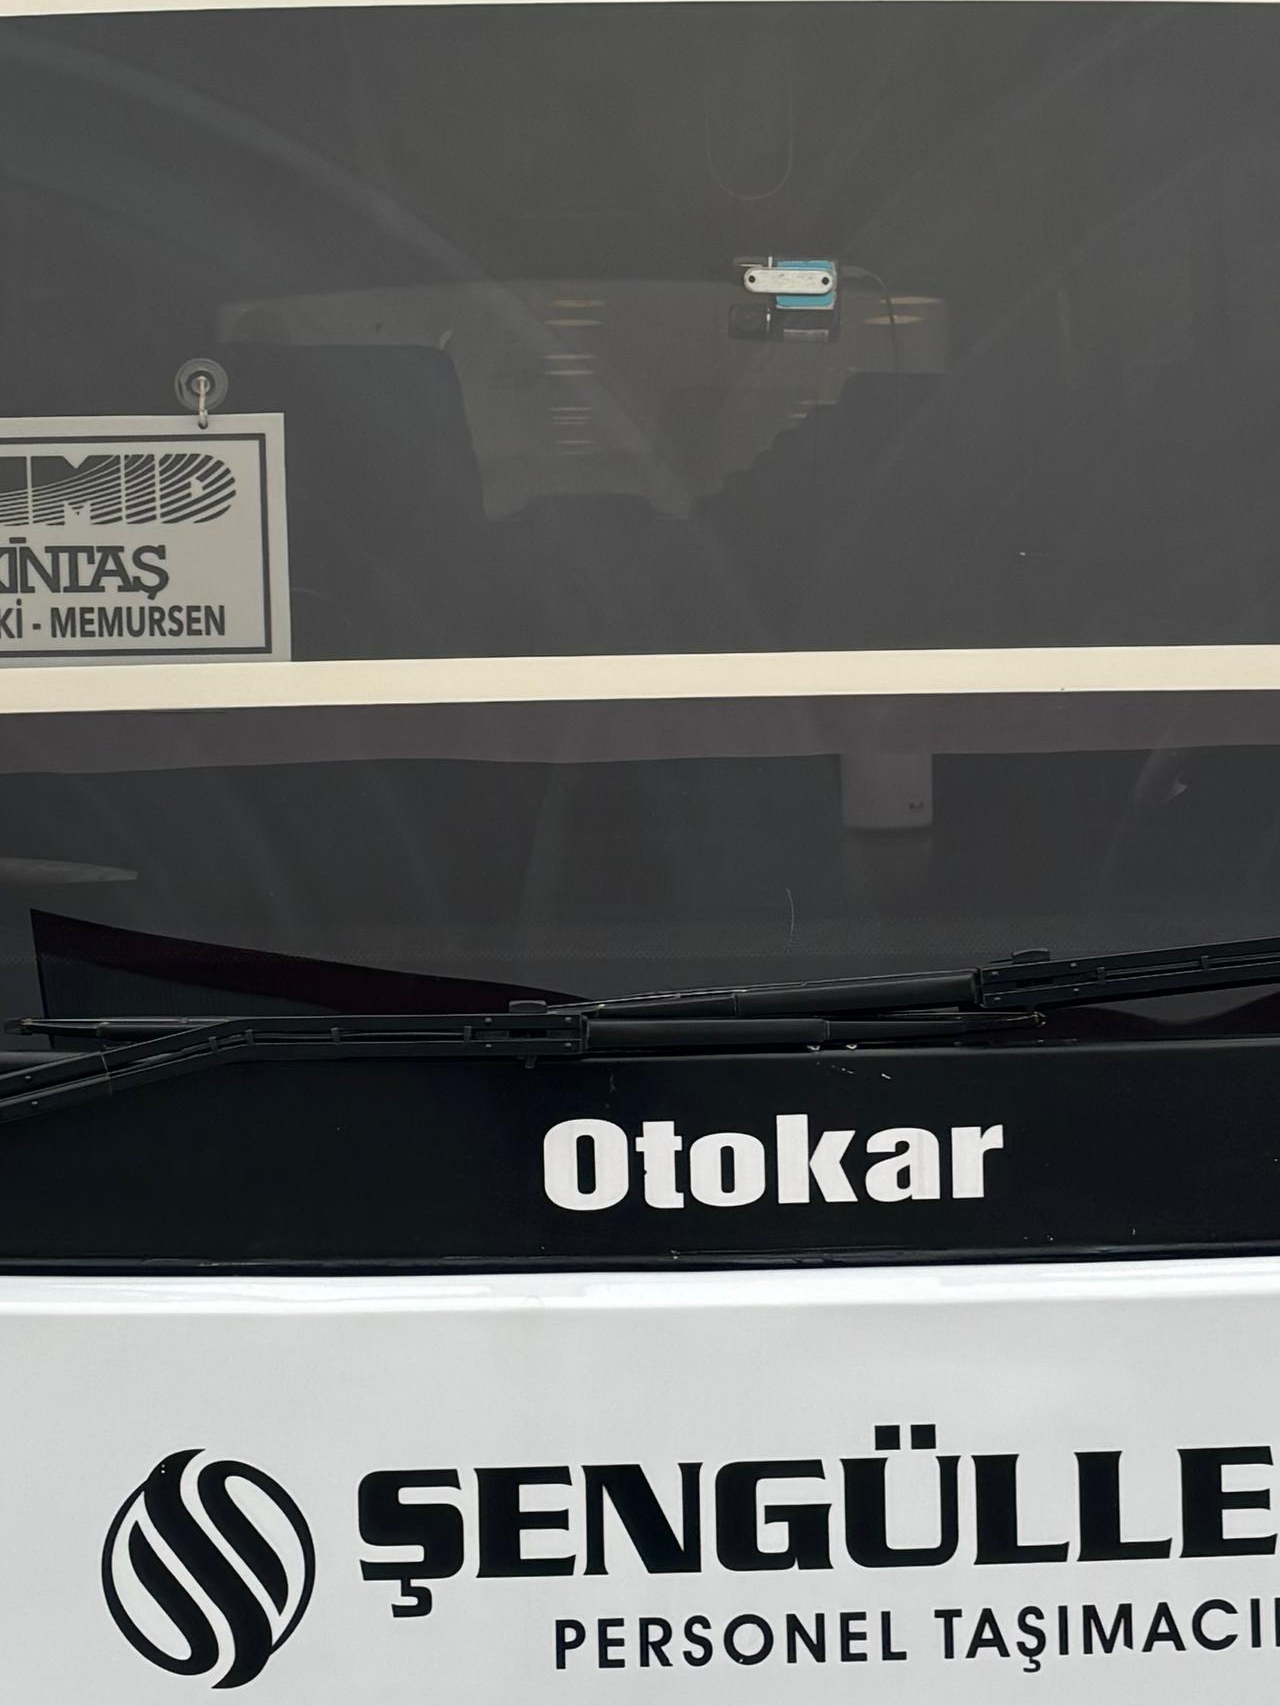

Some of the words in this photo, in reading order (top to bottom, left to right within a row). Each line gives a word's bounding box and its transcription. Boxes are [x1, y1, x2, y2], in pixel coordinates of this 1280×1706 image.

[50, 605, 226, 639] MEMURSEN
[543, 1114, 1005, 1211] Otokar
[555, 1610, 908, 1670] PERSONEL
